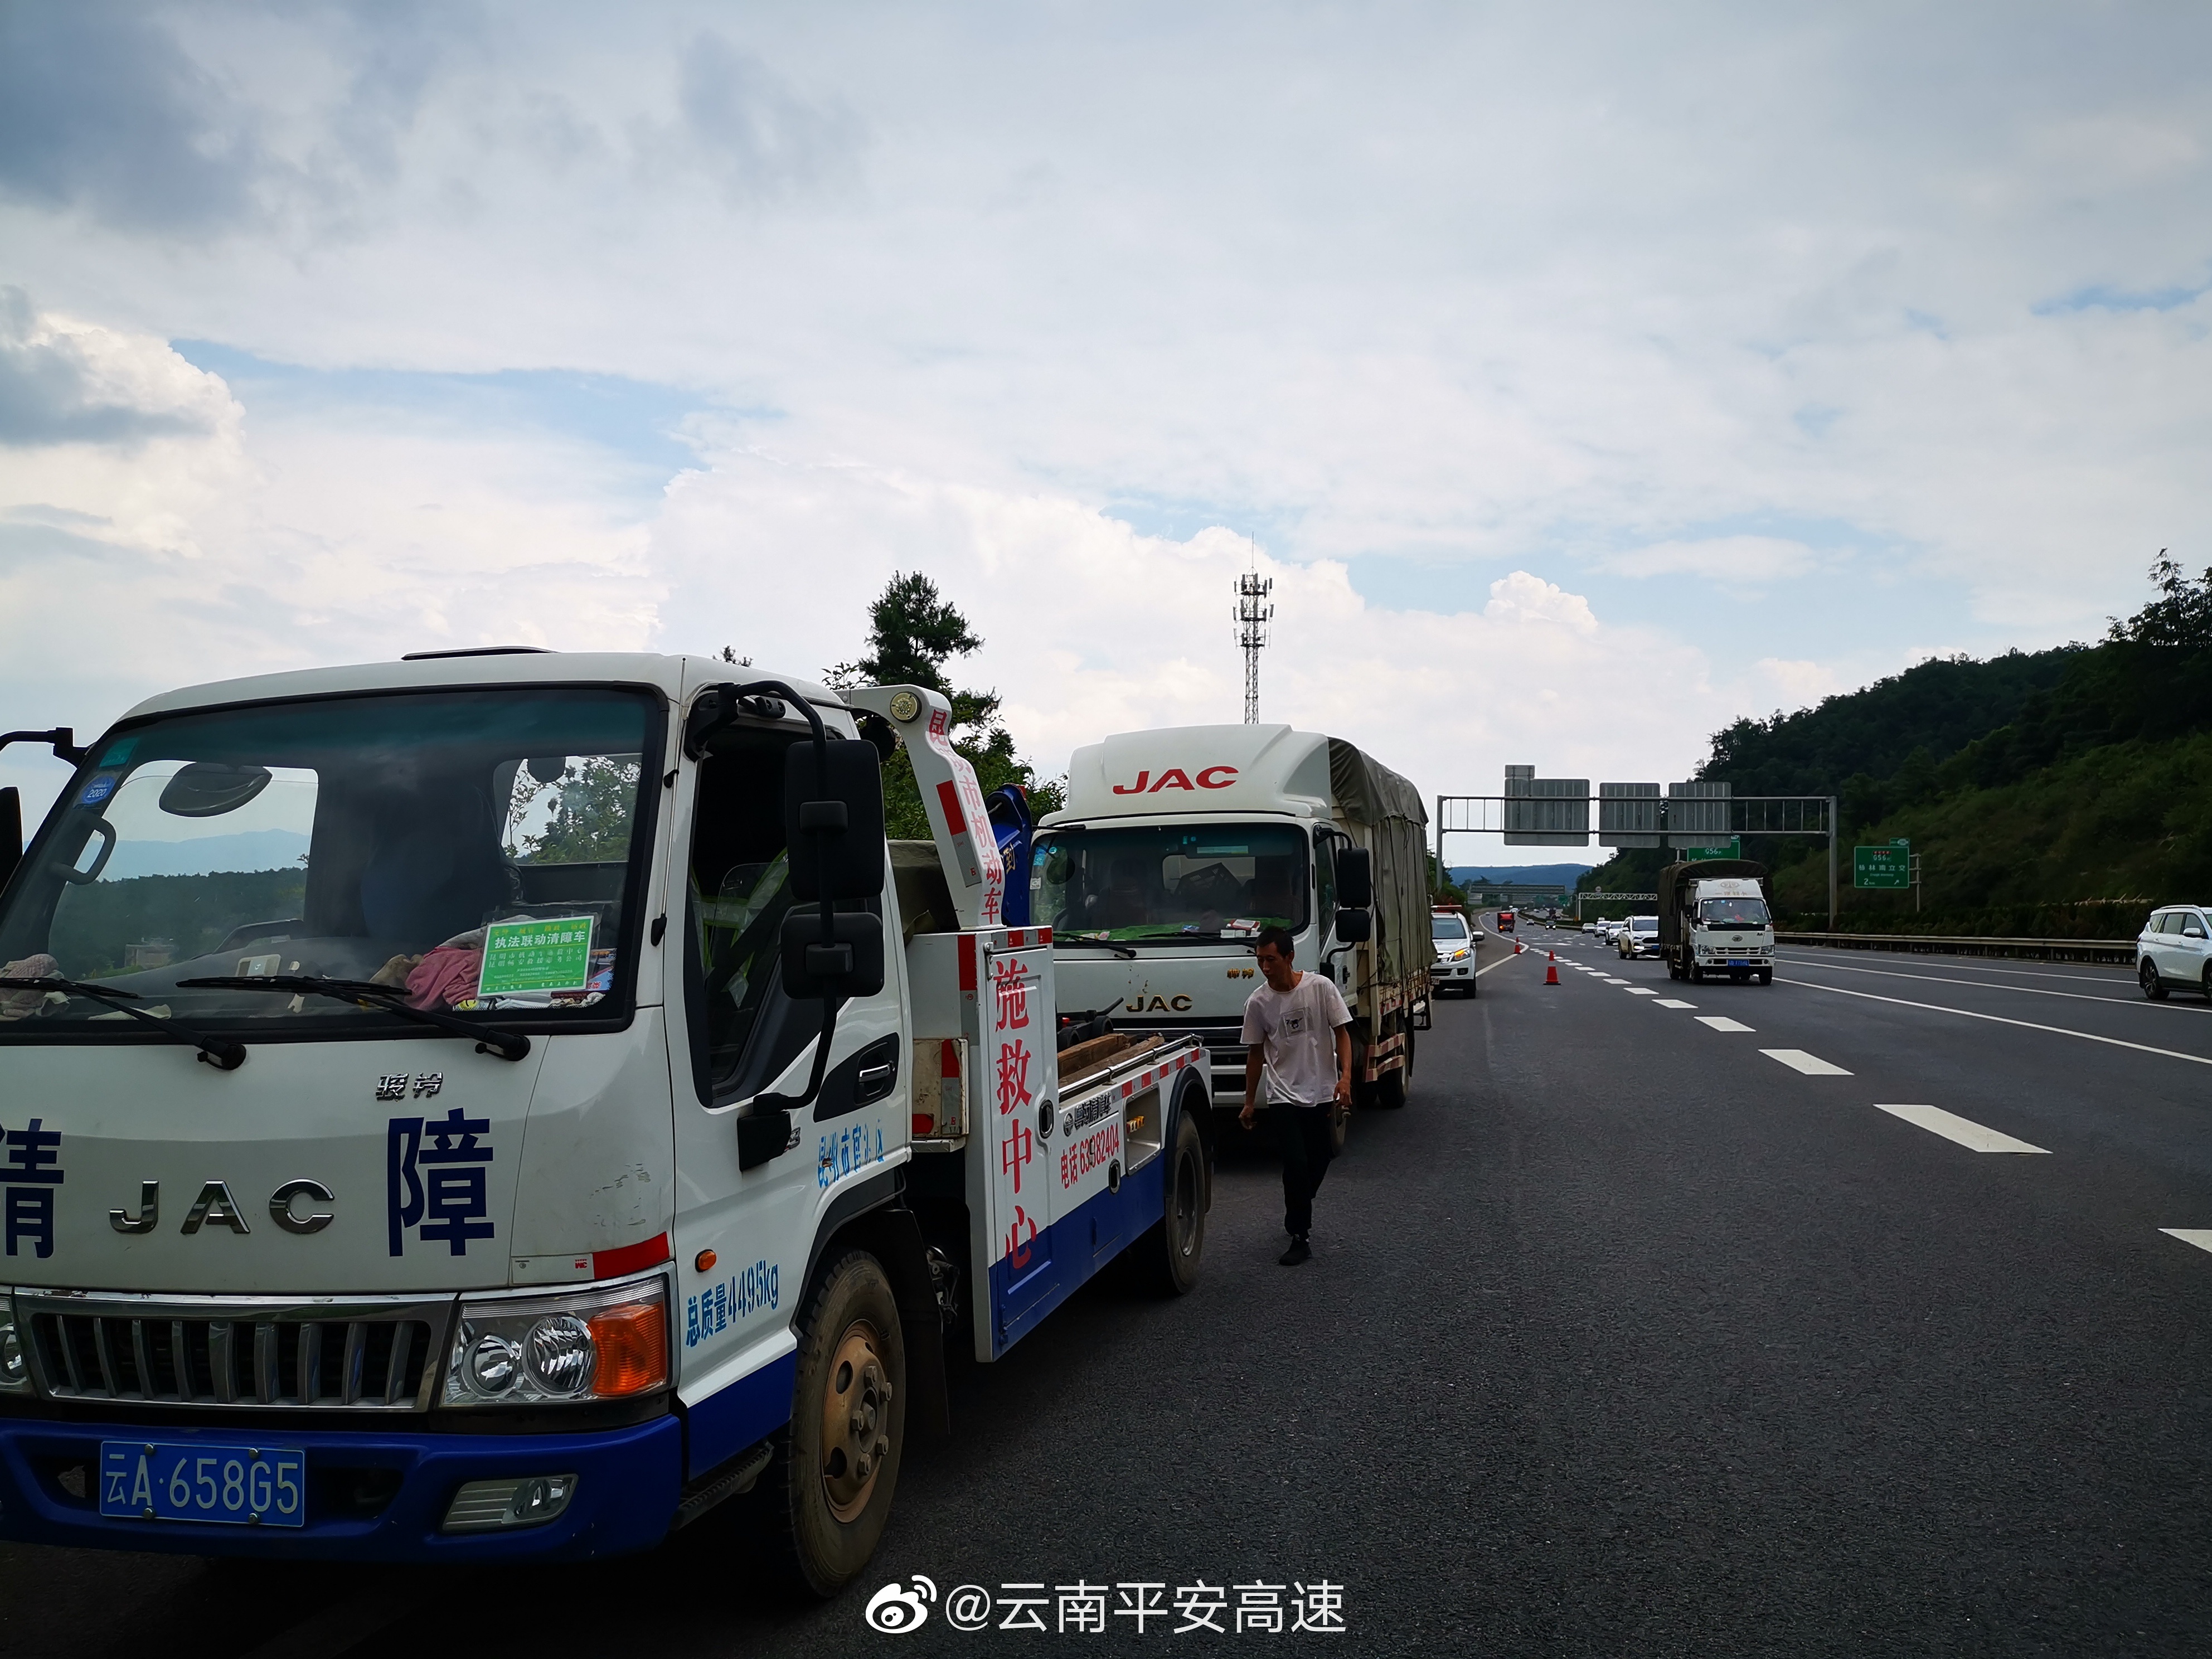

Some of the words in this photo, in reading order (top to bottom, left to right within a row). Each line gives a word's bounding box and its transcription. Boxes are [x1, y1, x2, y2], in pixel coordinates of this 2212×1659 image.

[86, 788, 107, 798] 2020
[1113, 766, 1239, 795] JAC
[494, 930, 586, 949] 执法联动清障车
[1126, 994, 1192, 1012] JAC
[375, 1072, 443, 1102] 骏铃
[993, 958, 1037, 1269] 施救中心
[387, 1107, 494, 1257] 障
[1061, 1144, 1078, 1189] 电话
[109, 1178, 334, 1235] JAC
[686, 1258, 778, 1348] 总质量4495kg
[105, 1453, 298, 1514] 云A·658G5
